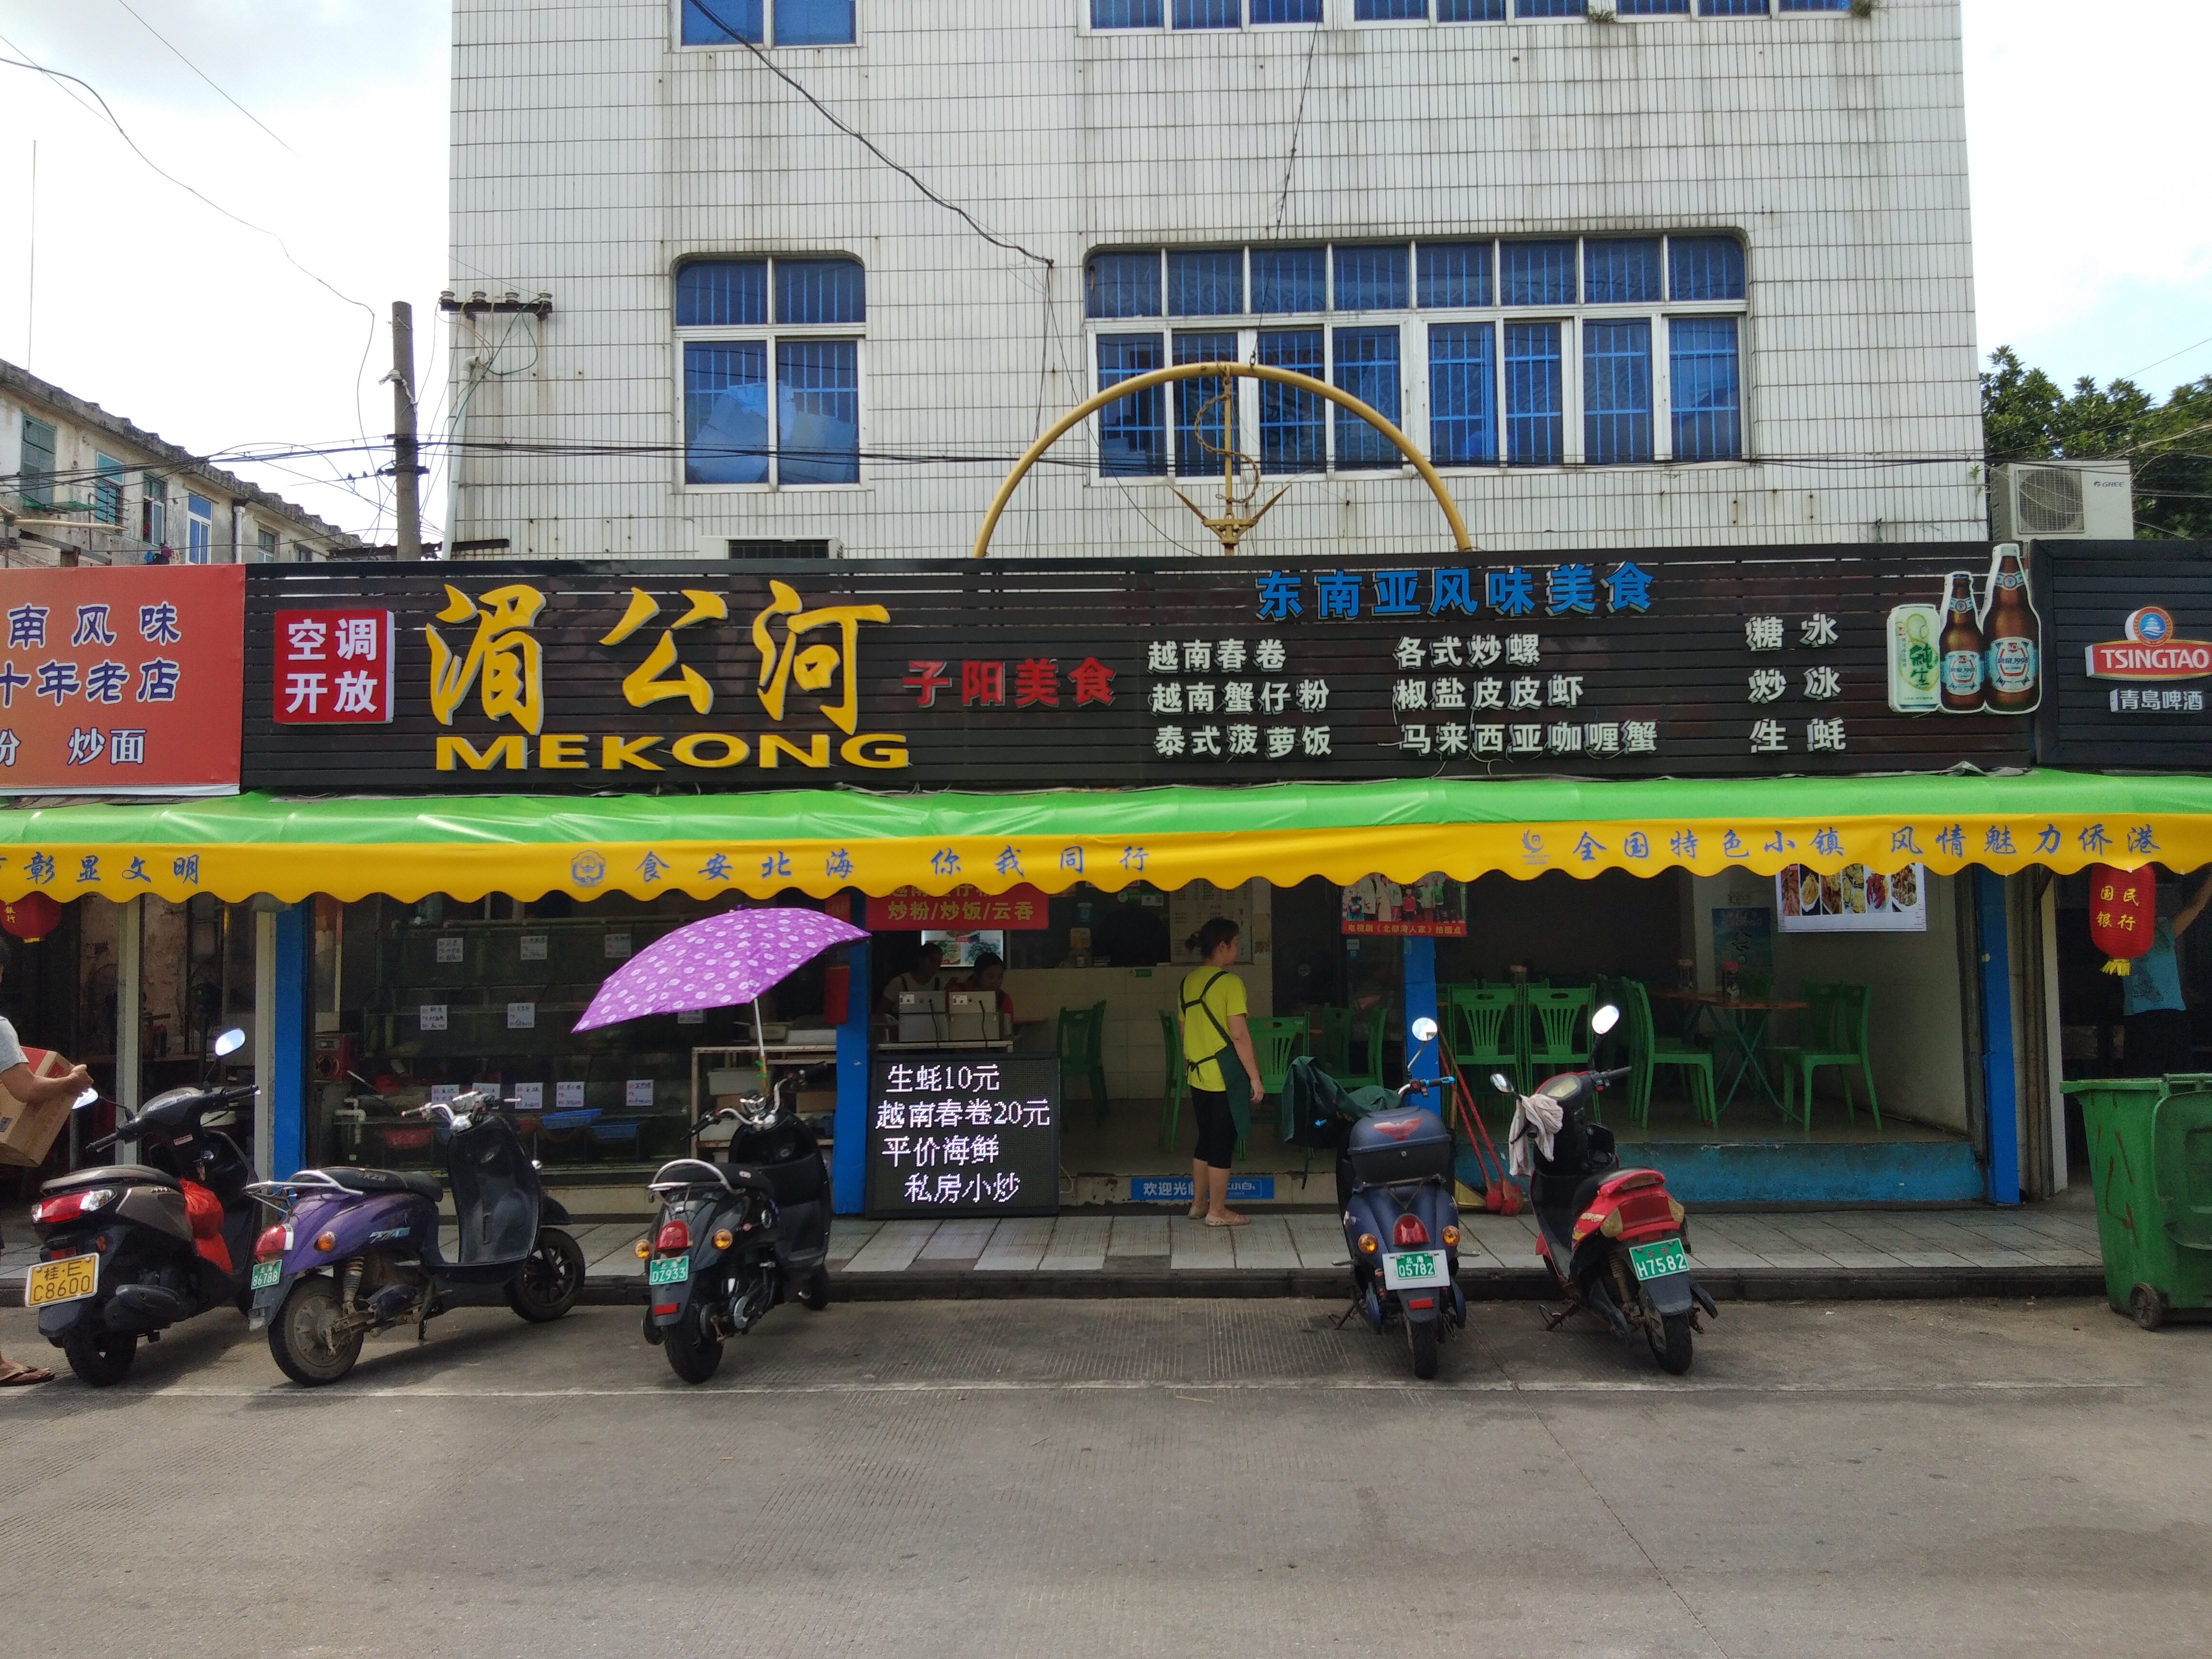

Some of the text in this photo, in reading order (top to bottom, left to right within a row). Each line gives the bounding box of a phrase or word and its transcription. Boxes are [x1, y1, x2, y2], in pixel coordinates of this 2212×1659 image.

[1258, 561, 1654, 619] 东南亚风味美食
[288, 618, 377, 661] 空调
[1746, 612, 1839, 650] 糖水
[425, 579, 890, 736] 湄公河
[1148, 638, 1287, 673] 越南春卷
[1395, 634, 1540, 669] 各式炒螺
[2100, 649, 2209, 669] TSINGTAO
[285, 672, 378, 714] 开放
[902, 657, 1116, 707] 子阳美食
[1152, 679, 1329, 714] 越南蟹仔粉
[1395, 674, 1584, 709] 椒盐皮皮虾
[1748, 666, 1843, 704] 炒冰
[68, 729, 146, 765] 炒面
[436, 733, 909, 771] MEKONG
[1155, 725, 1332, 757] 泰式菠萝饭
[1402, 721, 1656, 754] 马来西亚咖喱蟹
[1751, 719, 1847, 752] 生蚝
[1573, 824, 2160, 860] 全国特色小镇 风情魅力侨港
[0, 852, 200, 885] 彰显文明
[636, 845, 1149, 883] 食安北海 你我同行
[888, 900, 1033, 921] 炒粉/炒饭/云吞
[2100, 885, 2139, 907] 国民
[2096, 912, 2136, 932] 银行
[886, 1064, 999, 1093] 生蚝10元
[875, 1098, 1050, 1130] 越南春卷20元
[882, 1134, 999, 1167] 平价海鲜
[904, 1172, 1021, 1203] 私房小炒
[253, 1271, 278, 1286] 86788
[652, 1267, 685, 1282] DZ933
[1399, 1262, 1434, 1276] Q5782
[1636, 1253, 1686, 1277] H7582
[34, 1275, 90, 1301] C8600
